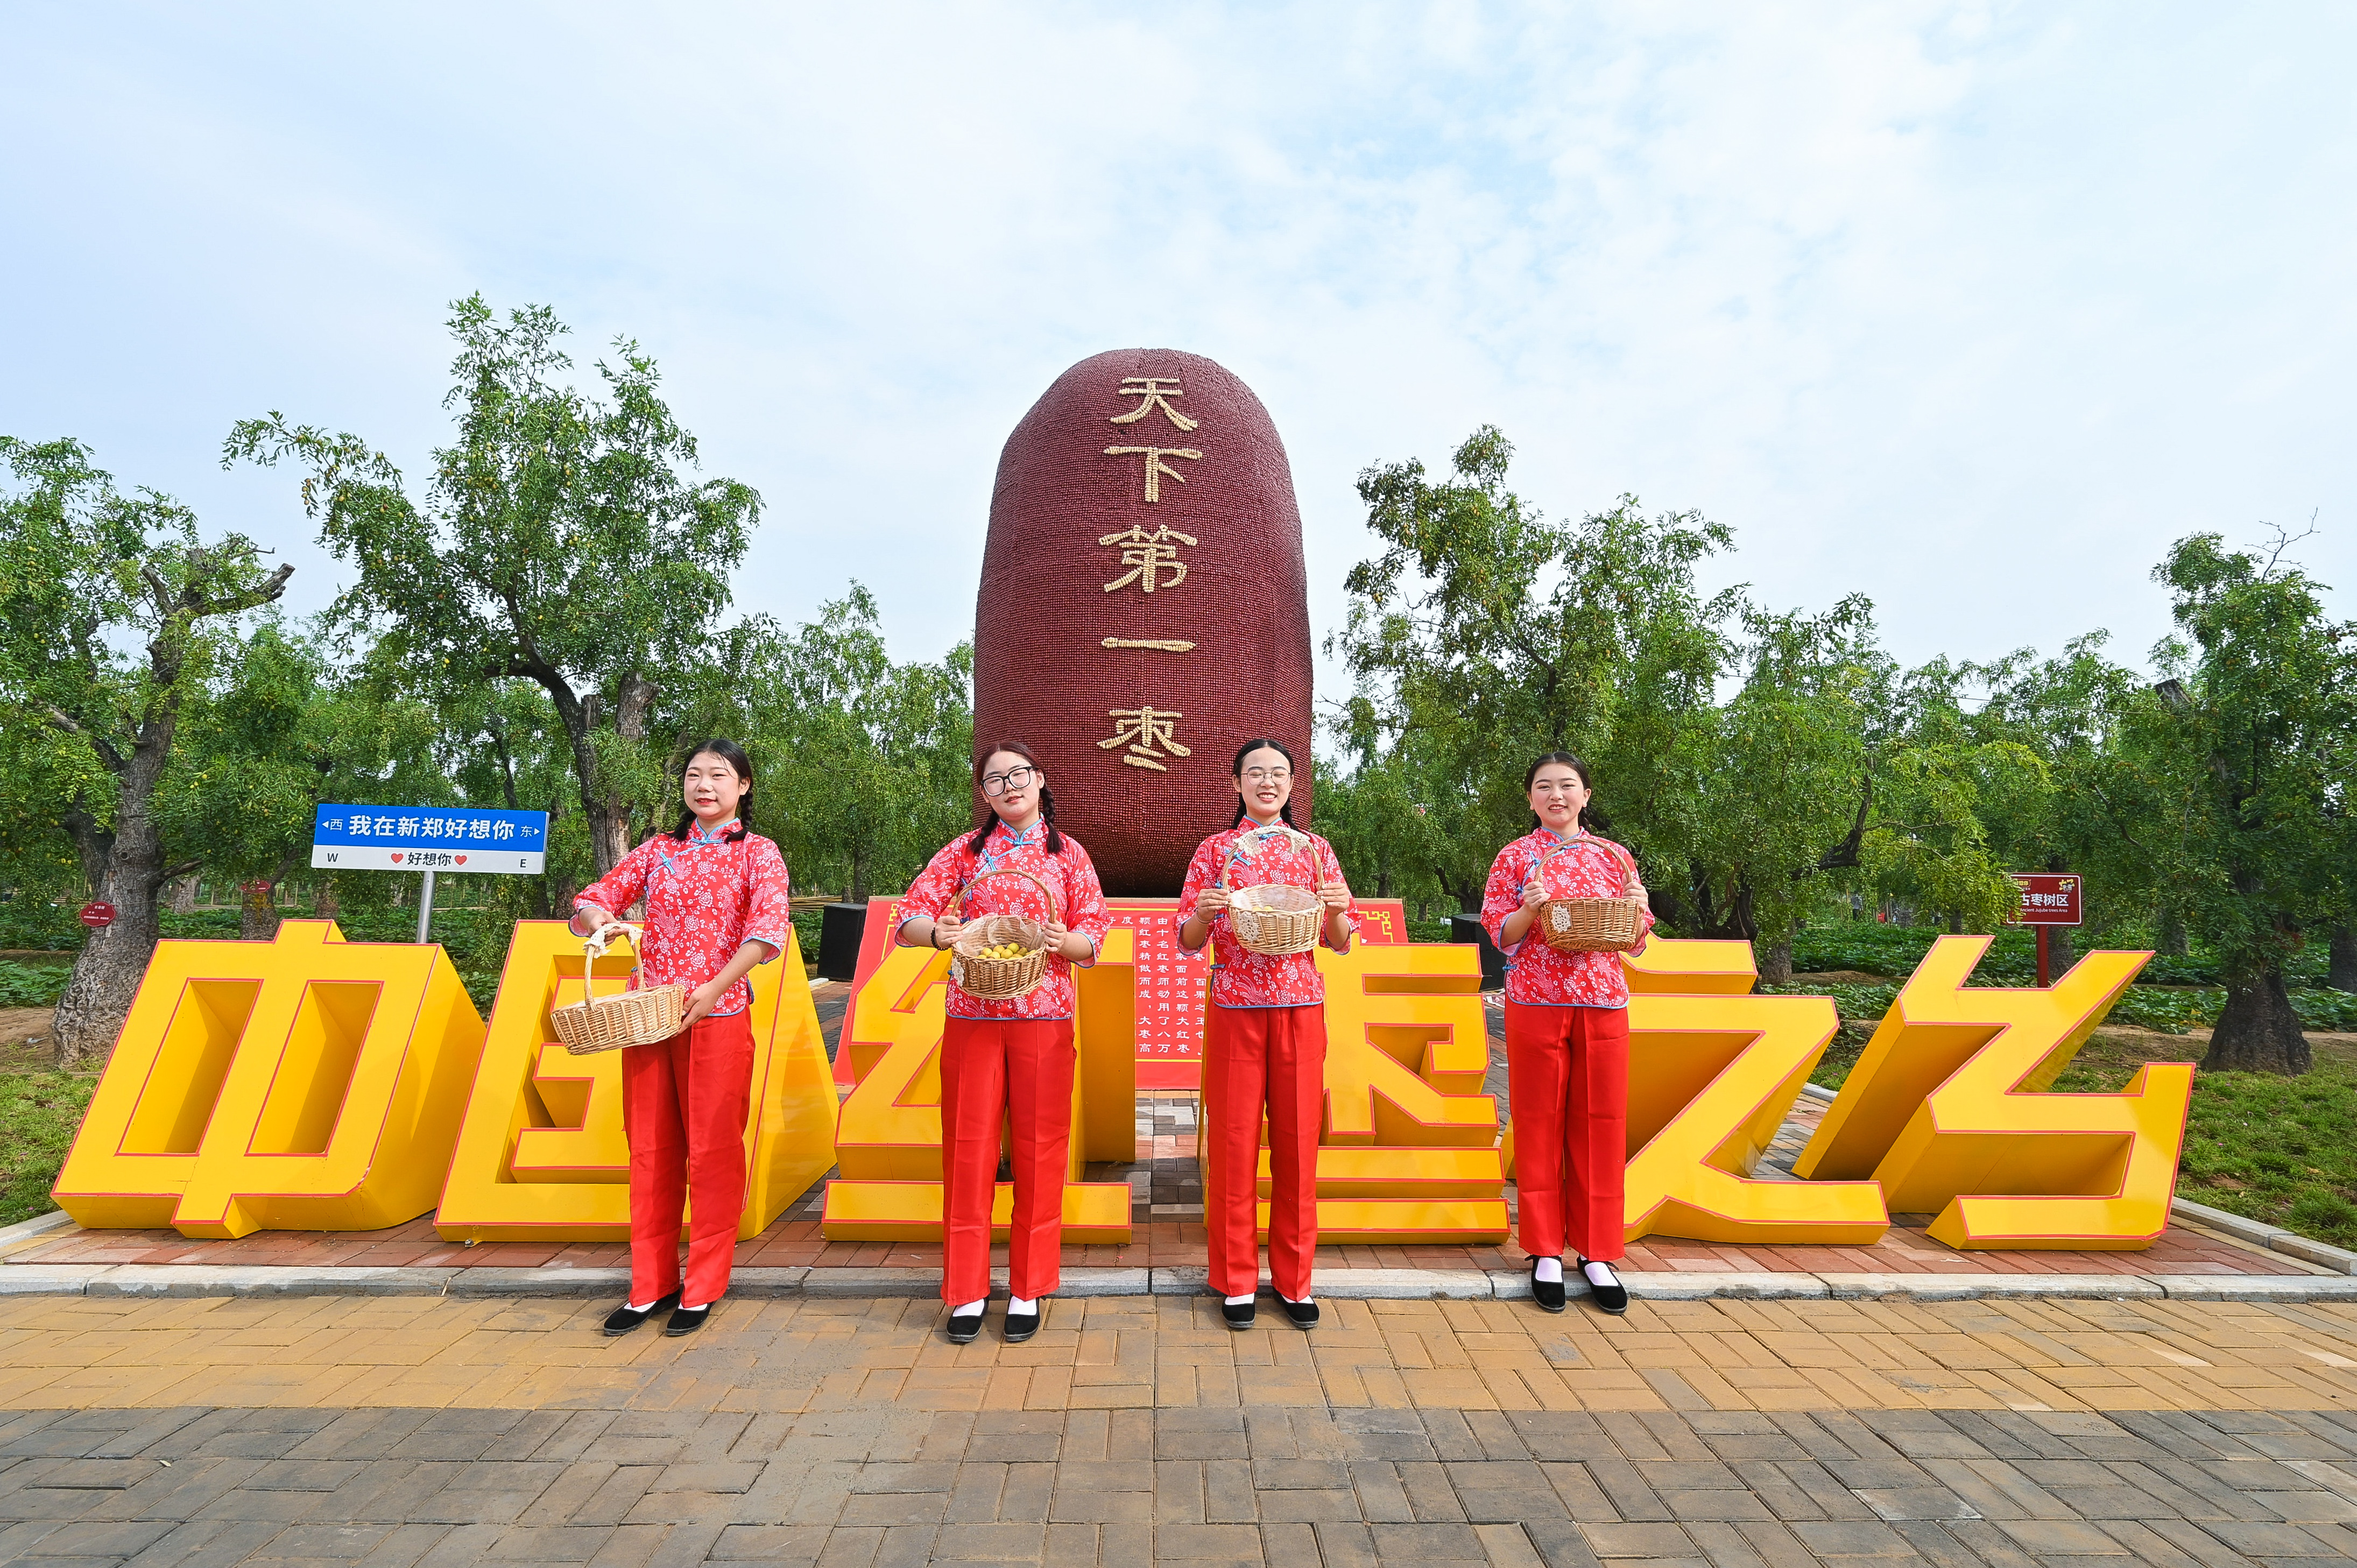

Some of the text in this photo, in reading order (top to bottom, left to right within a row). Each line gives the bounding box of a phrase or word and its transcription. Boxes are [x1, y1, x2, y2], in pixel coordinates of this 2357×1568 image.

[1096, 377, 1203, 772] 天下第一枣
[327, 852, 527, 868] W 好想你 E
[329, 814, 533, 841] 西 我在新郑好想你 东
[2020, 893, 2069, 907] 古枣树区
[1156, 917, 1171, 1053] 由十名红枣师动用了八万
[1174, 945, 1190, 1053] 家面前这颗大红枣
